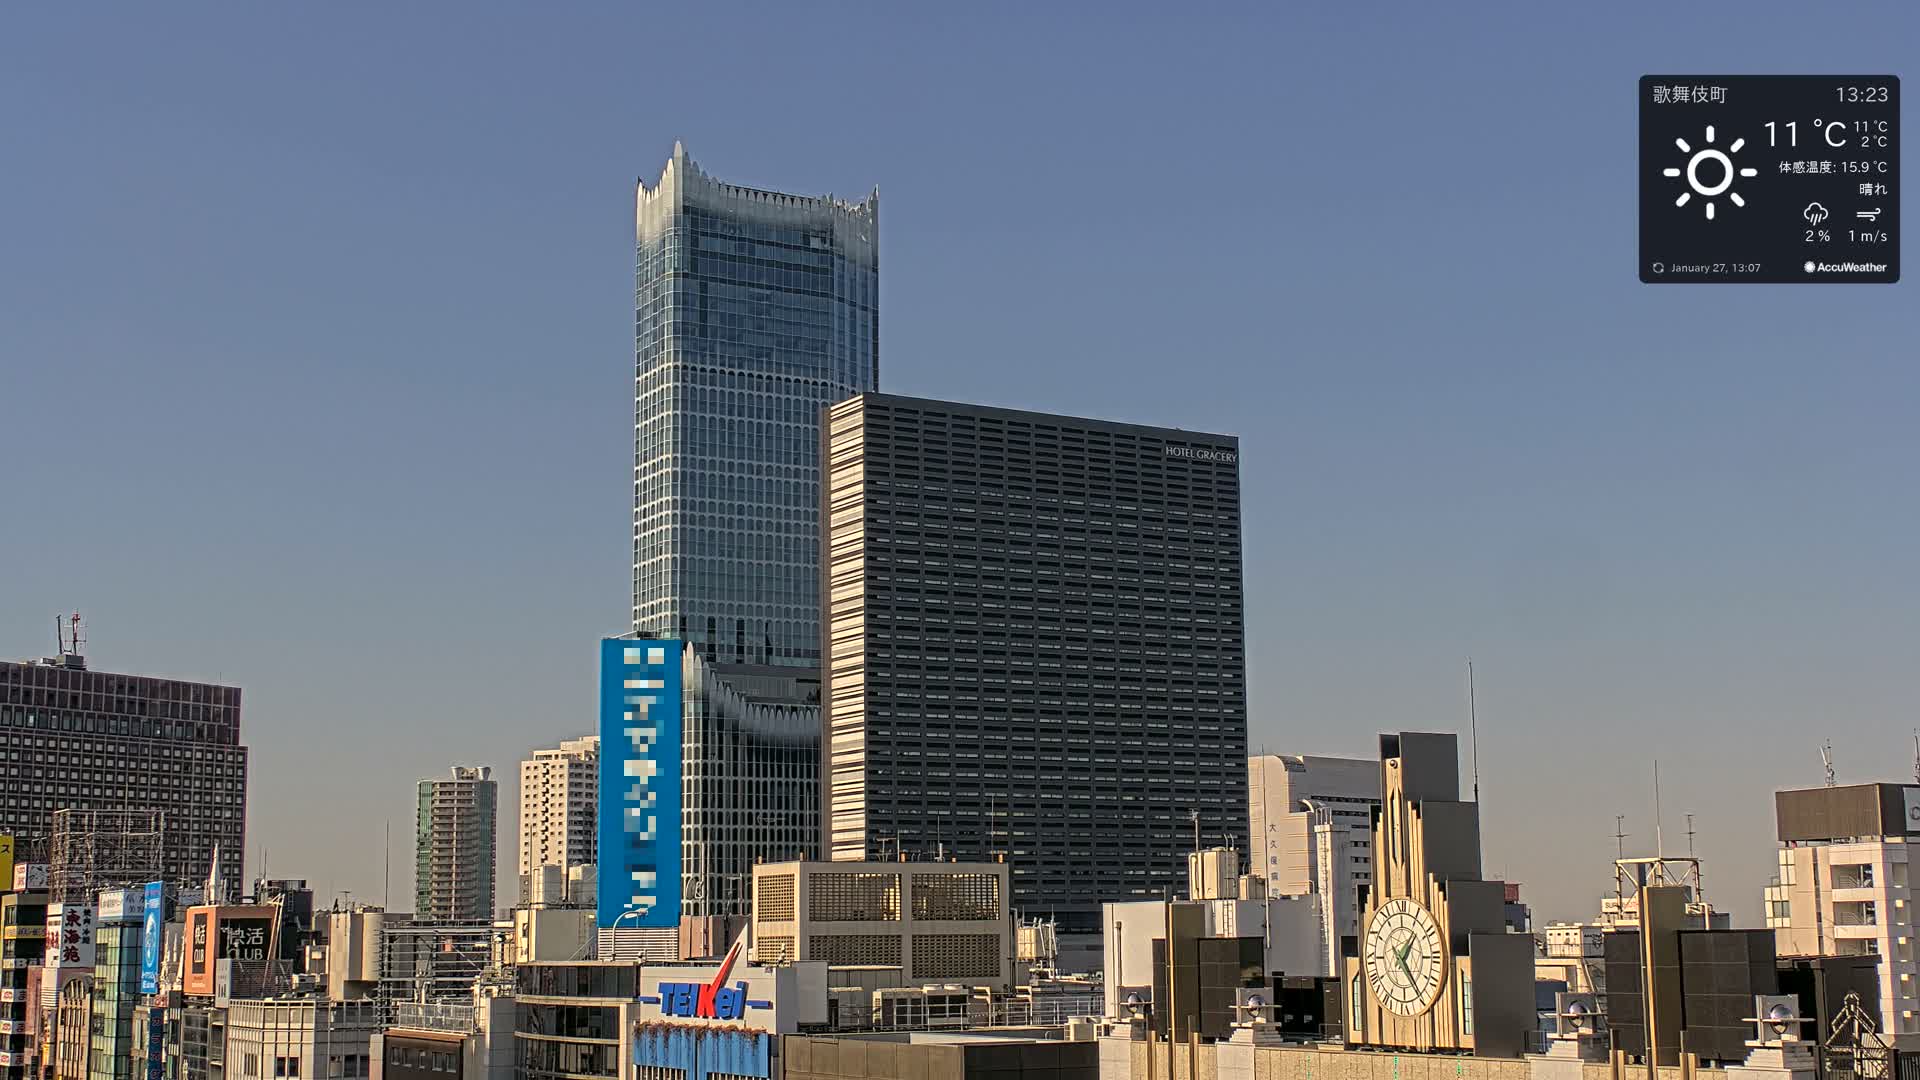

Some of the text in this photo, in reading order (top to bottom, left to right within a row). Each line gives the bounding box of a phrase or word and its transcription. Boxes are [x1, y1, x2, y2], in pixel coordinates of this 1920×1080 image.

[1166, 446, 1237, 462] HOTEL GRACERY
[63, 908, 82, 963] 東海苑
[229, 927, 264, 945] 快活
